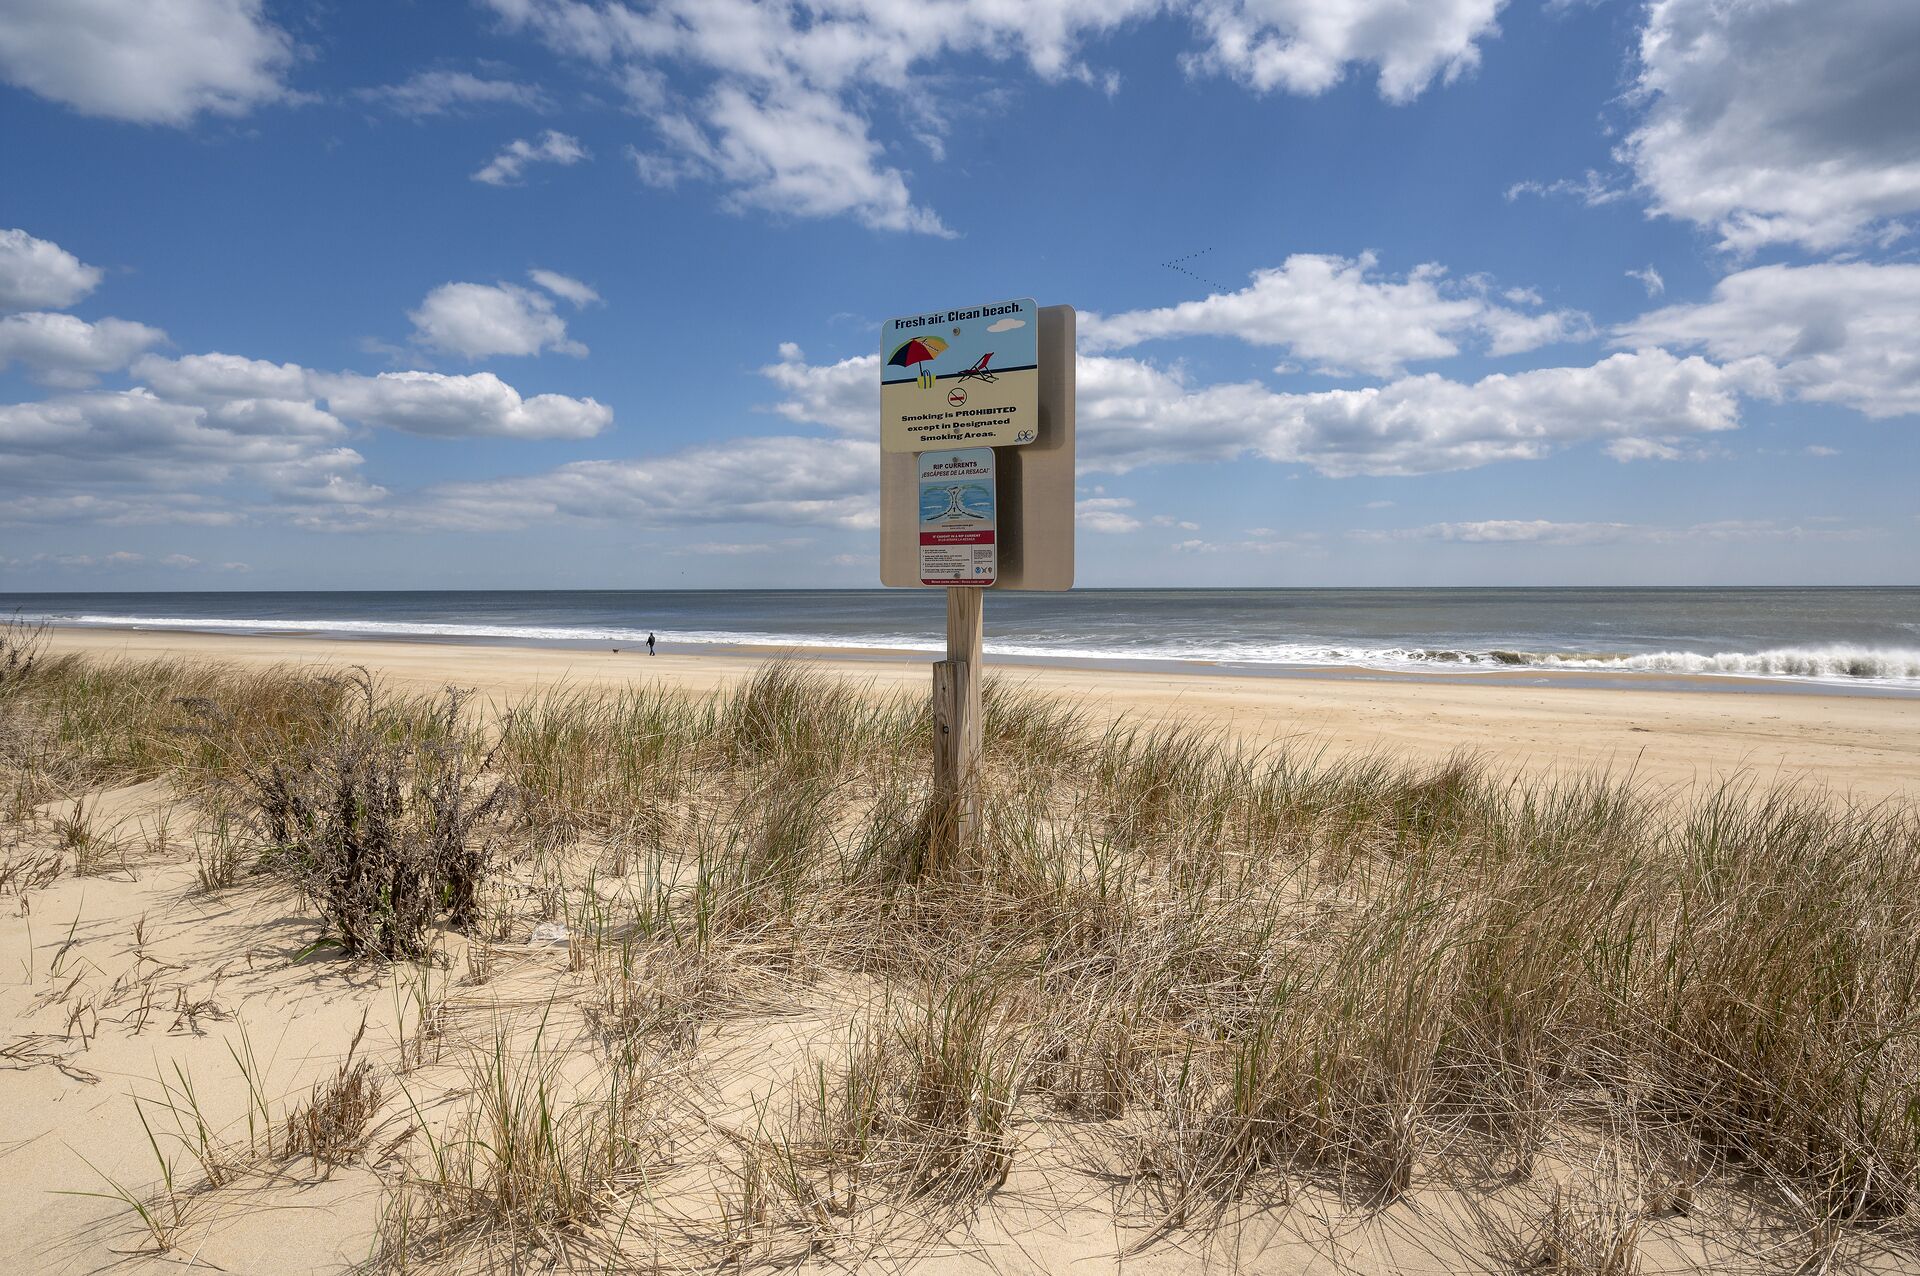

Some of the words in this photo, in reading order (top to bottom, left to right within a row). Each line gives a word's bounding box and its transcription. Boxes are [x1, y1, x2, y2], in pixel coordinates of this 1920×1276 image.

[895, 316, 925, 330] Fresh
[928, 314, 945, 325] air.
[948, 309, 980, 322] Clean
[983, 302, 1023, 317] beach.
[901, 413, 944, 422] Smoking
[955, 406, 1017, 417] PROHIBITED
[907, 424, 939, 432] except
[952, 418, 1010, 429] Designated
[920, 433, 963, 442] Smoking
[964, 431, 996, 439] Areas.
[944, 461, 978, 469] CURRENTS
